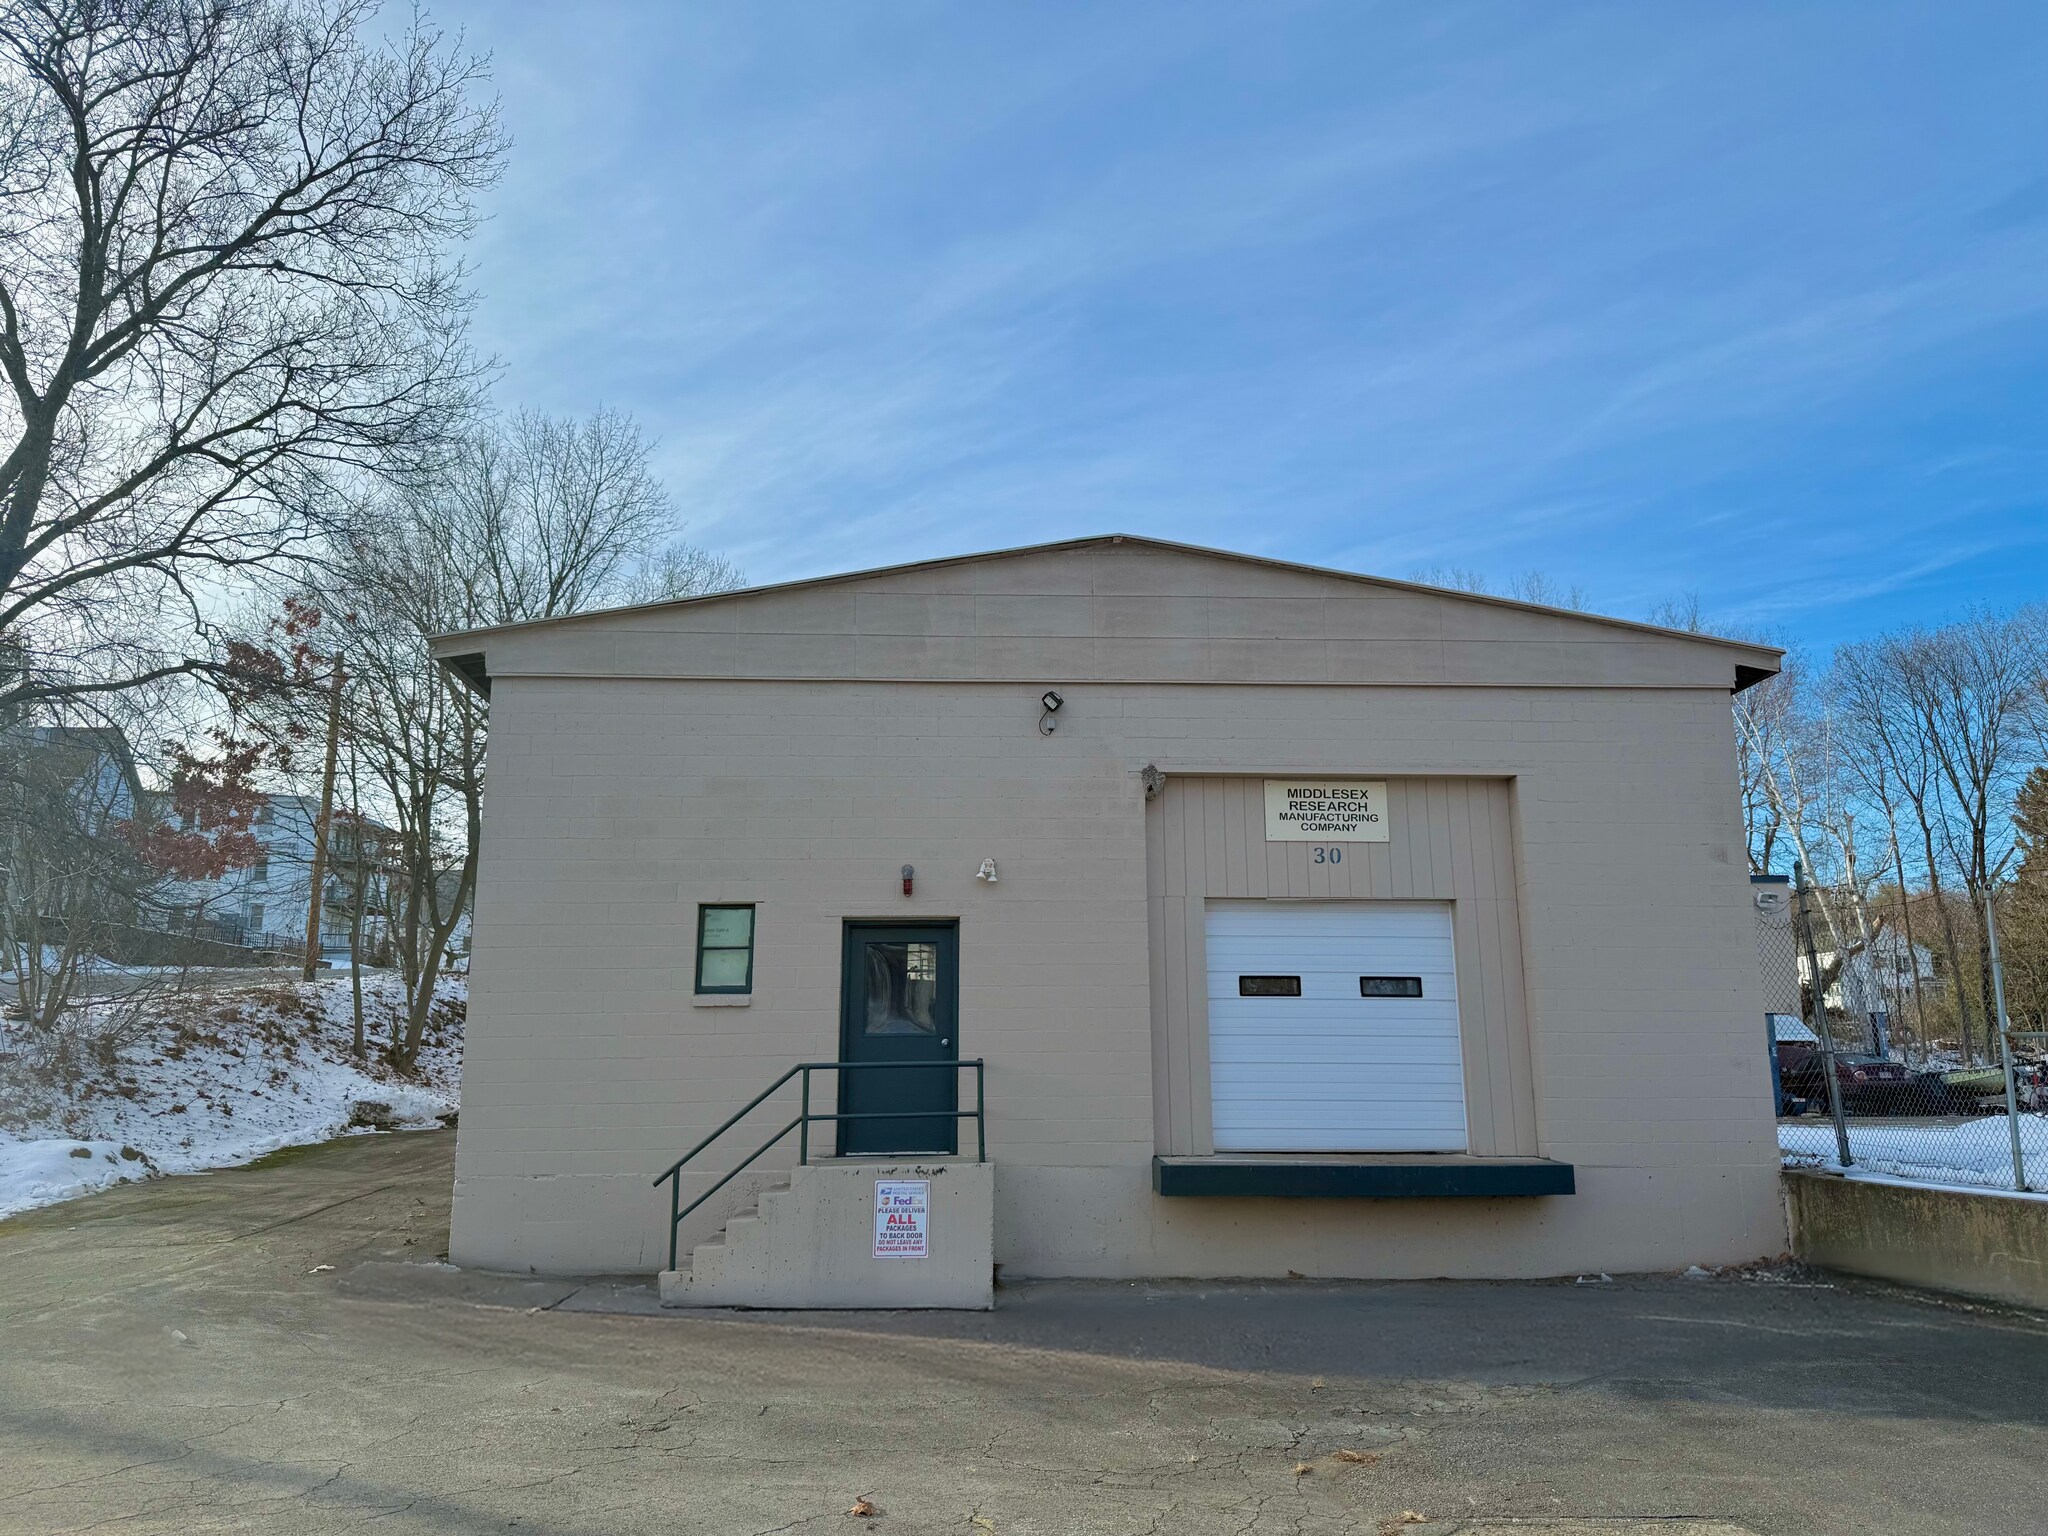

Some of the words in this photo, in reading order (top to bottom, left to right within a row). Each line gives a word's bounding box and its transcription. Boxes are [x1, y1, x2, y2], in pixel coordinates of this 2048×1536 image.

[1287, 788, 1369, 800] MIDDLESEX
[1289, 801, 1368, 812] RESEARCH
[1279, 812, 1379, 823] MANUFACTURING
[1300, 823, 1358, 832] COMPANY
[1313, 847, 1342, 864] 30
[887, 1214, 917, 1224] ALL
